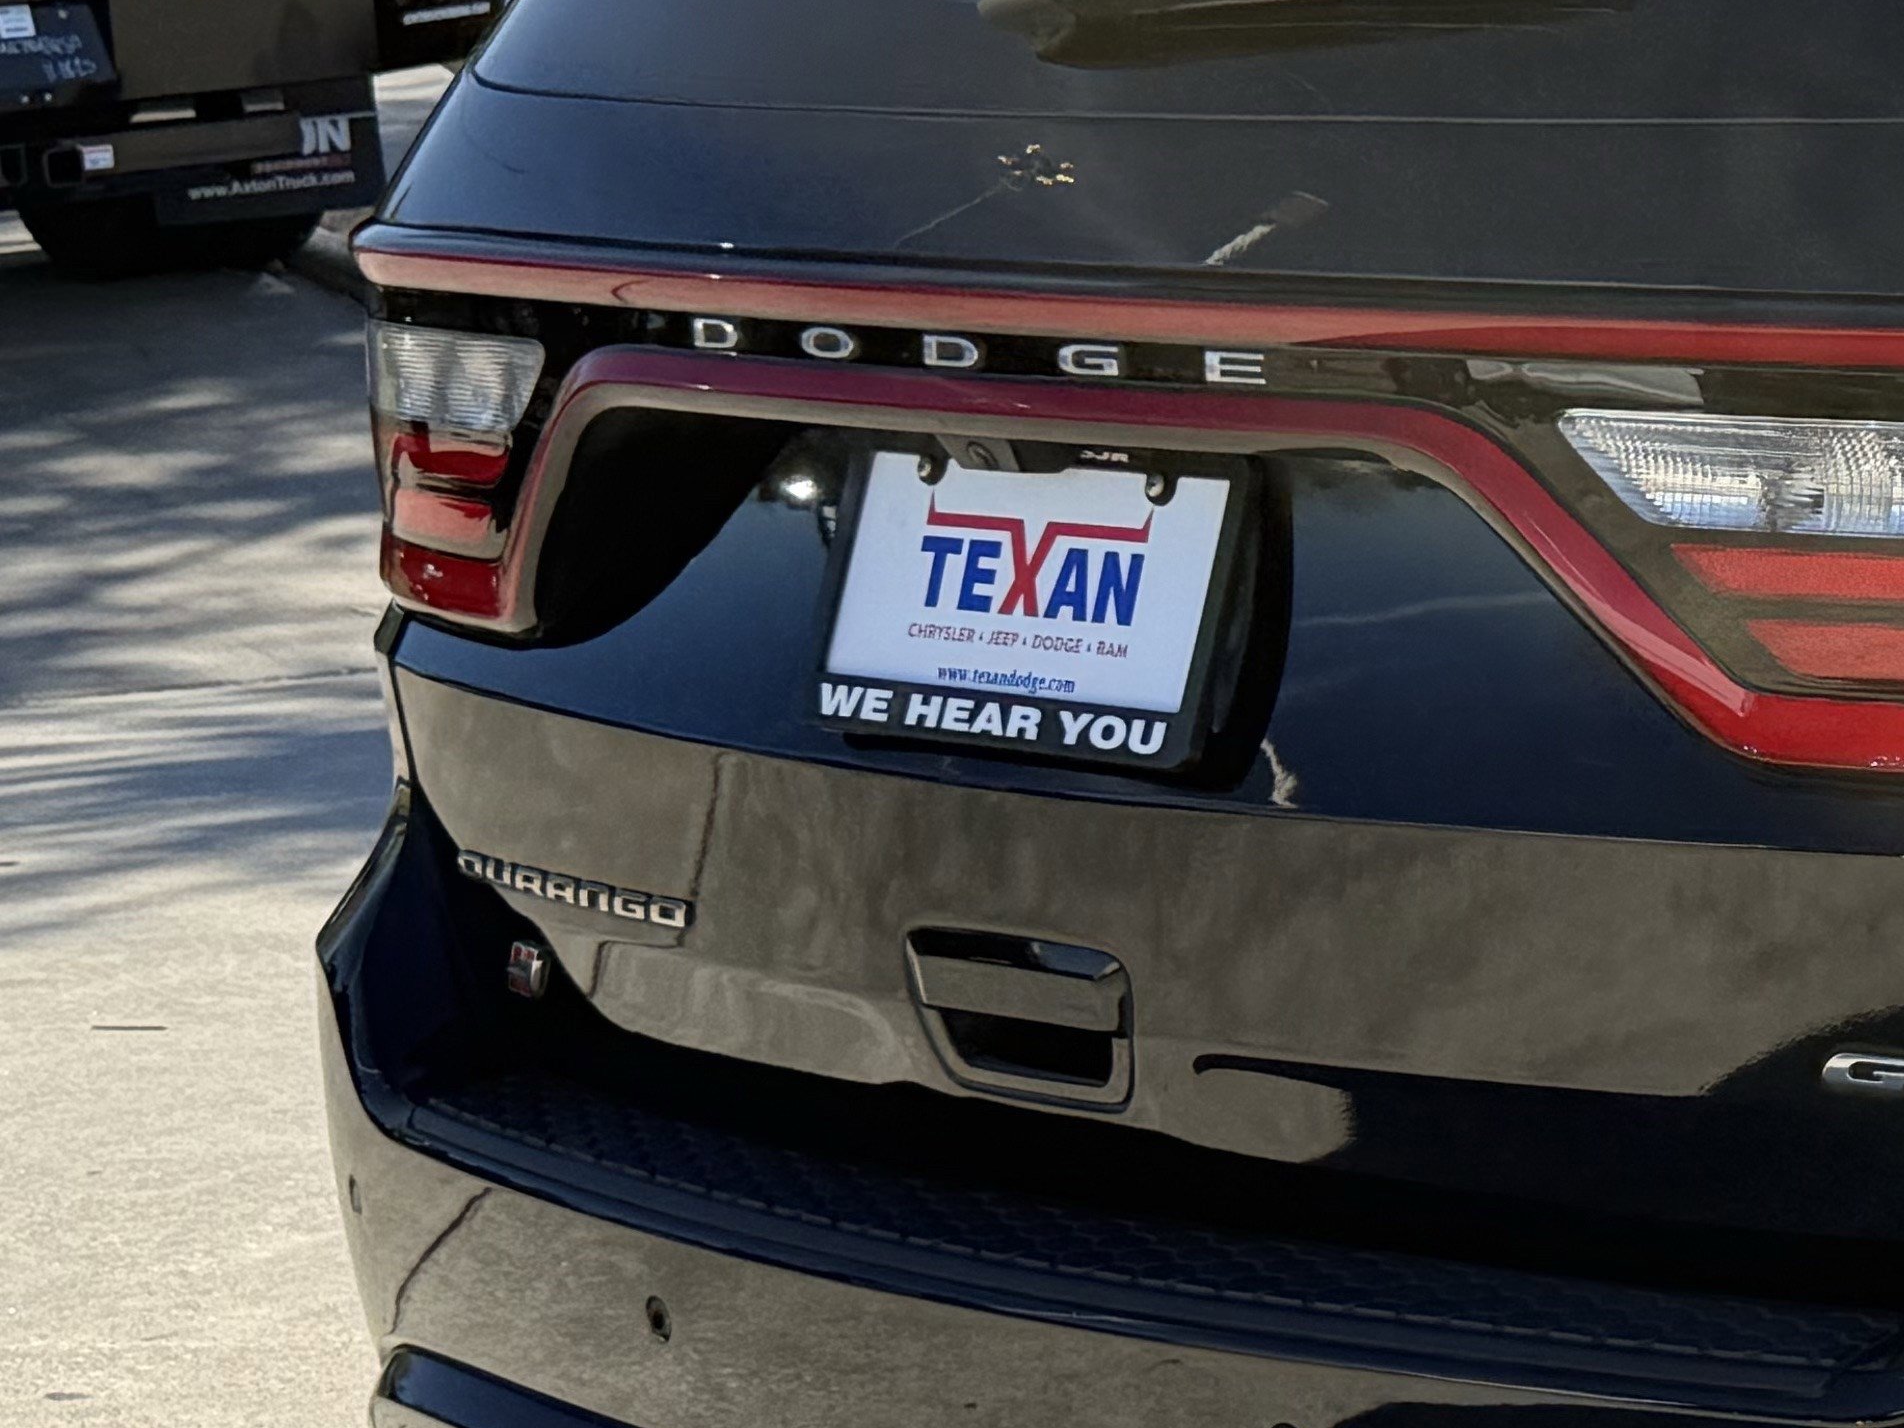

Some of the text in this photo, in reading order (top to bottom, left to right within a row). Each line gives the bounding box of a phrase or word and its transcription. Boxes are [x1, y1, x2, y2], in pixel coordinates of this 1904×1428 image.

[693, 317, 1267, 386] DODGE
[921, 517, 1145, 627] TEXAN
[908, 623, 1129, 658] CHRYSLER JEEP DODGE RAM
[936, 666, 1076, 694] www.texandodge.com
[820, 682, 1168, 756] WE HEAR YOU
[457, 851, 690, 928] DURANGO
